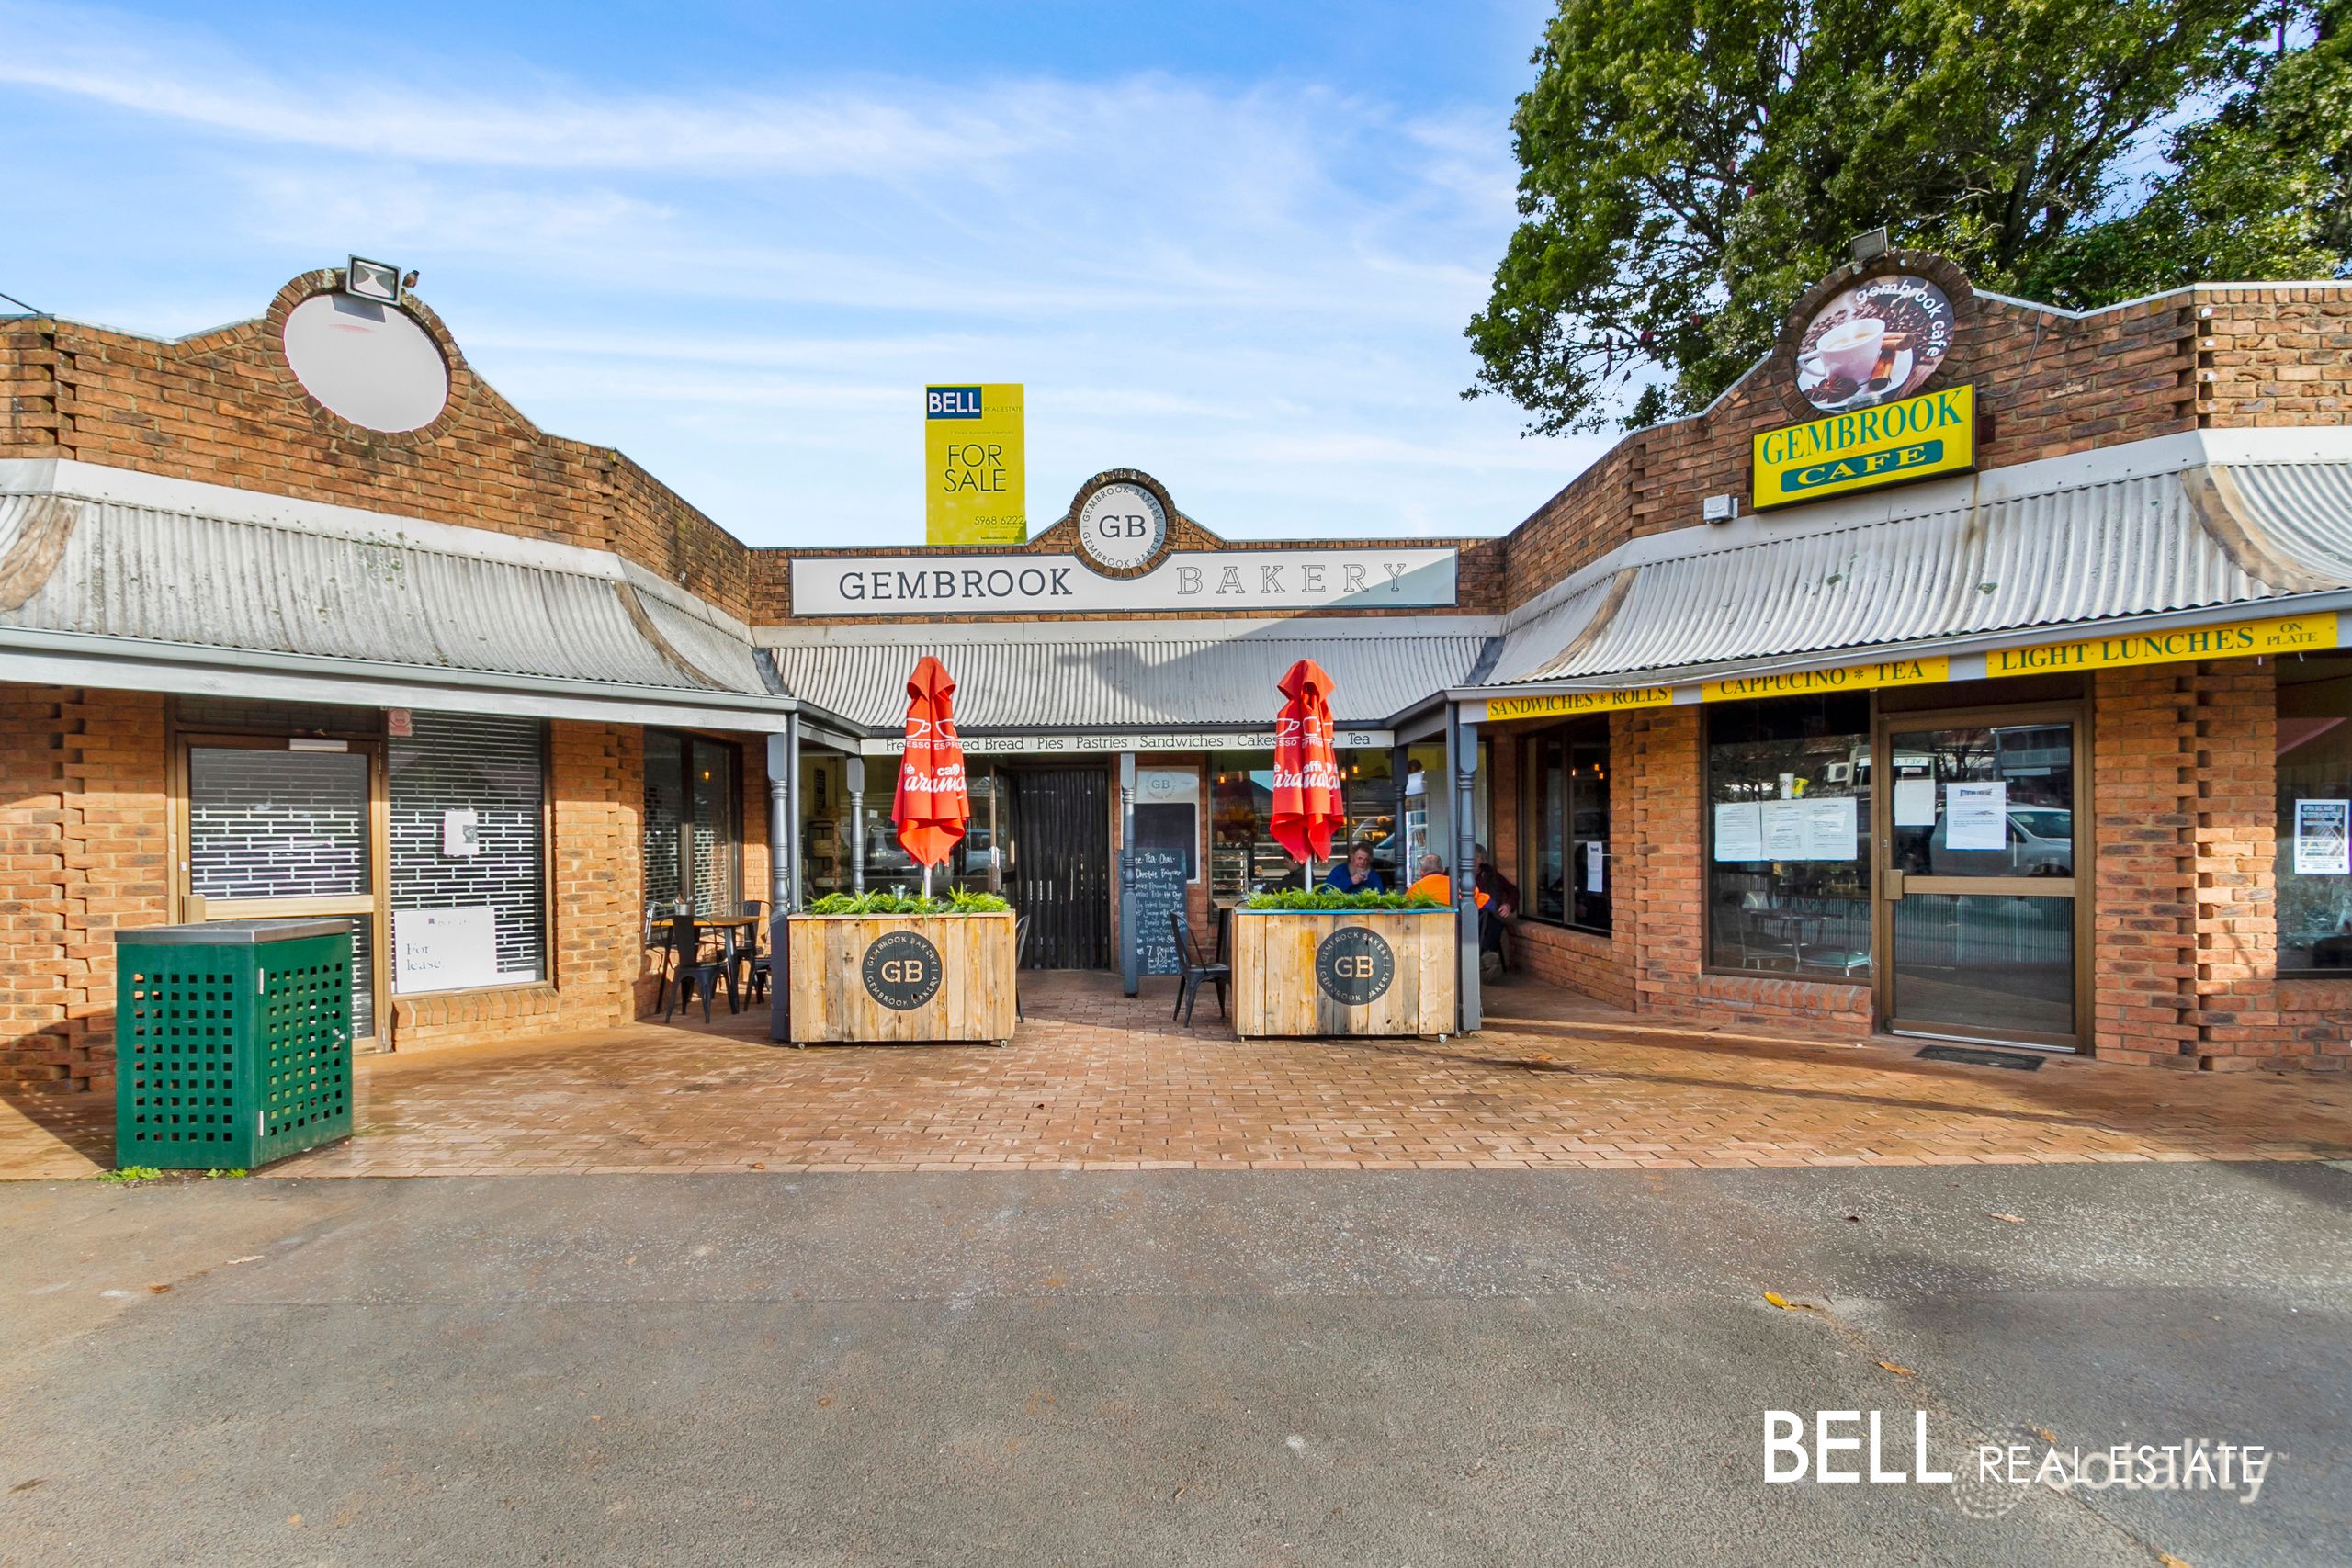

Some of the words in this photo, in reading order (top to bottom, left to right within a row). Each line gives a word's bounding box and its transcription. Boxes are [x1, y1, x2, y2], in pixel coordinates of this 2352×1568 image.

[1856, 279, 1945, 319] gembrook
[1926, 321, 1947, 356] cafe
[928, 392, 980, 413] BELL
[1762, 389, 1964, 465] GEMBROOK
[948, 444, 1002, 468] FOR
[1797, 446, 1927, 485] CAFE
[944, 468, 1007, 492] SALE
[1082, 485, 1130, 522] GEMBROOK
[1133, 487, 1163, 521] BAKERY
[974, 515, 998, 525] 5968
[1000, 515, 1024, 525] 6222
[1099, 514, 1147, 538] GB
[1082, 531, 1130, 568] GEMBROOK
[1134, 531, 1163, 566] BAKERY
[839, 568, 1073, 600] GEMBROOK
[1176, 563, 1407, 595] BAKERY
[2267, 632, 2318, 646] PLATE
[2279, 622, 2304, 634] ON
[2001, 643, 2089, 671] LIGHT
[2102, 626, 2255, 661] LUNCHES
[1720, 667, 1847, 695] CAPPUCINO
[1874, 660, 1925, 682] TEA
[1490, 693, 1594, 716] SANDWICHES
[1611, 687, 1669, 705] ROLLS
[906, 740, 931, 750] ESSO
[985, 737, 1024, 750] Bread
[1037, 737, 1064, 750] Pies
[1076, 736, 1128, 750] Pastries
[1139, 734, 1224, 749] Sandwiches
[1237, 734, 1278, 748] Cakes
[1348, 732, 1371, 746] Tea
[1151, 779, 1170, 789] GB
[407, 943, 429, 955] For
[881, 960, 923, 984] GB
[1334, 955, 1374, 978] GB
